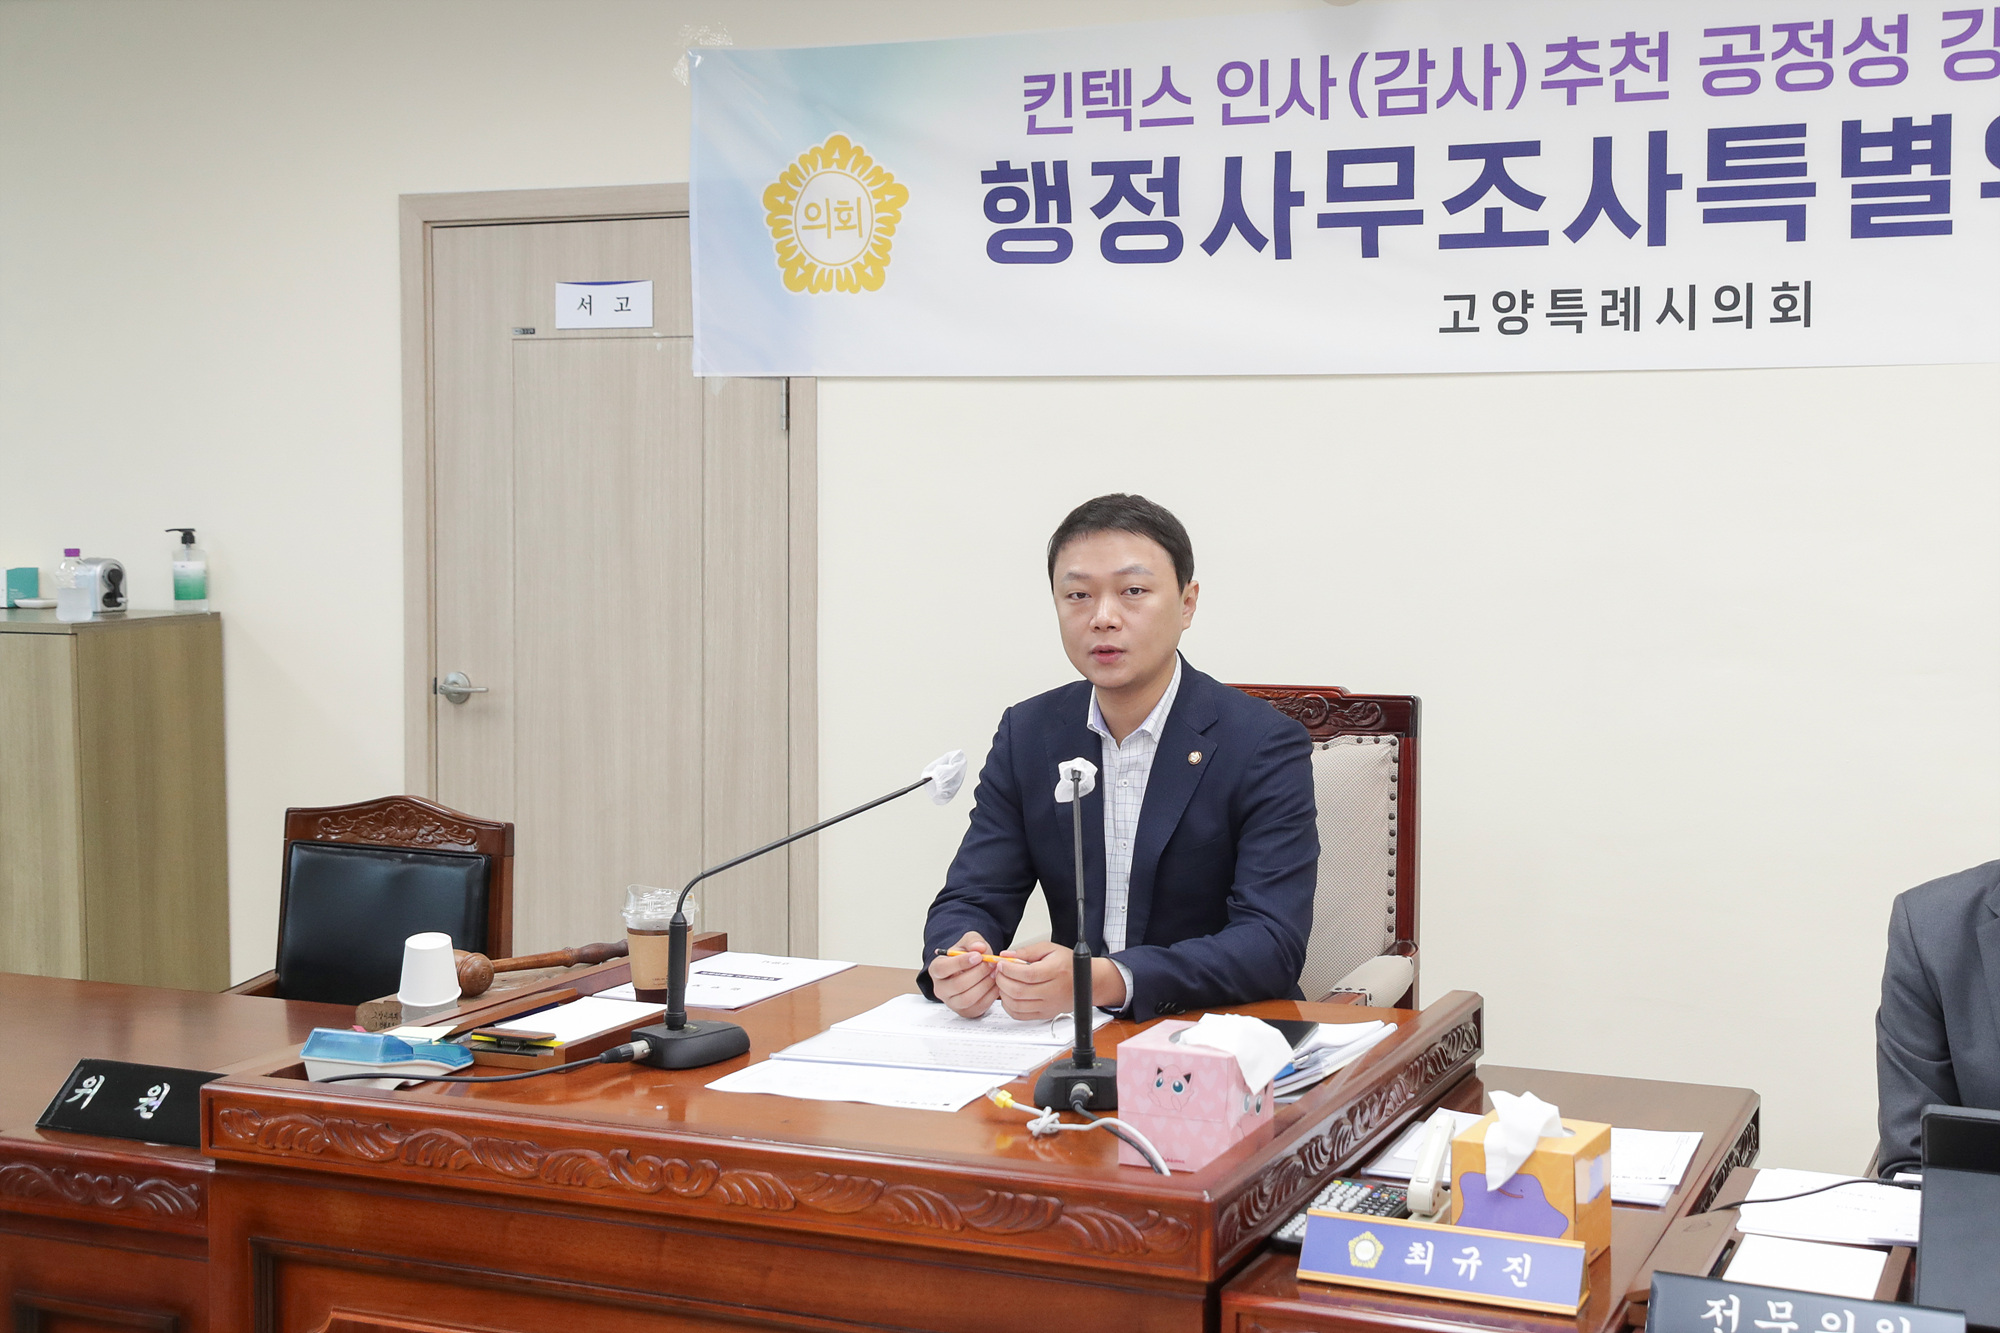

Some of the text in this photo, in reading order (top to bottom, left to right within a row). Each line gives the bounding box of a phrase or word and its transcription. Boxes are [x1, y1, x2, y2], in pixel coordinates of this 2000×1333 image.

[1023, 65, 1194, 135] 킨텍스
[1699, 13, 1909, 97] 공정성
[981, 113, 2000, 264] 행정사무조사특별
[801, 200, 864, 239] 의회
[1438, 280, 1813, 336] 고양특례시의회
[1404, 1240, 1532, 1288] 최규진
